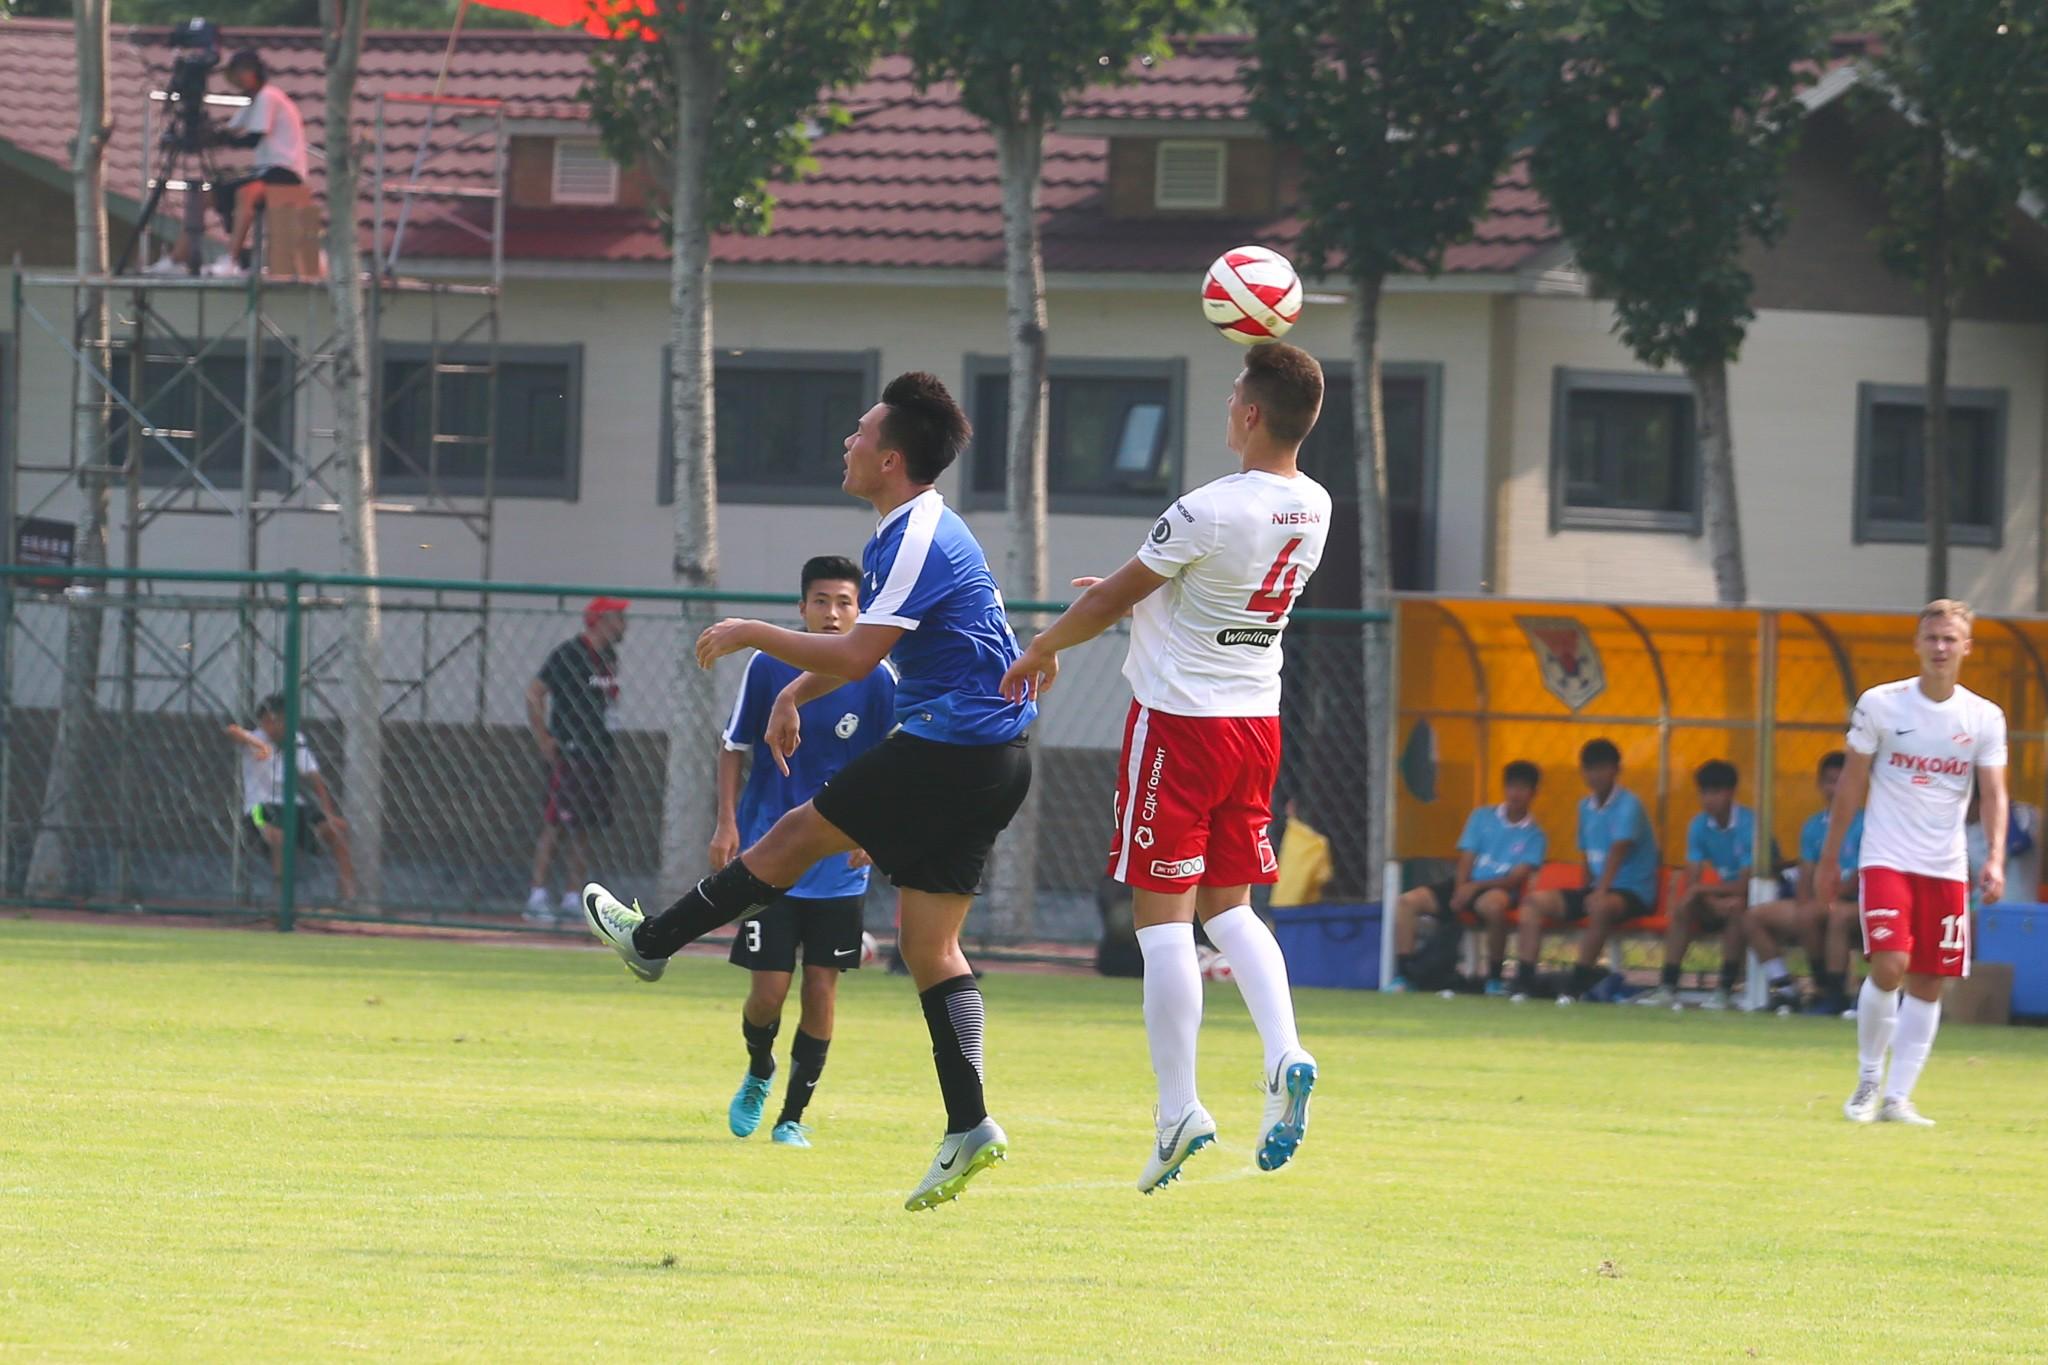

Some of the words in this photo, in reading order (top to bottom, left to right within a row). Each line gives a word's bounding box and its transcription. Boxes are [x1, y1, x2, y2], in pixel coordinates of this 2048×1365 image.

[1272, 512, 1320, 525] NISSAN
[1245, 537, 1303, 623] 4
[1223, 631, 1278, 645] Winline
[1142, 791, 1158, 821] СДК
[744, 920, 761, 952] 3
[1939, 914, 1964, 949] 11
